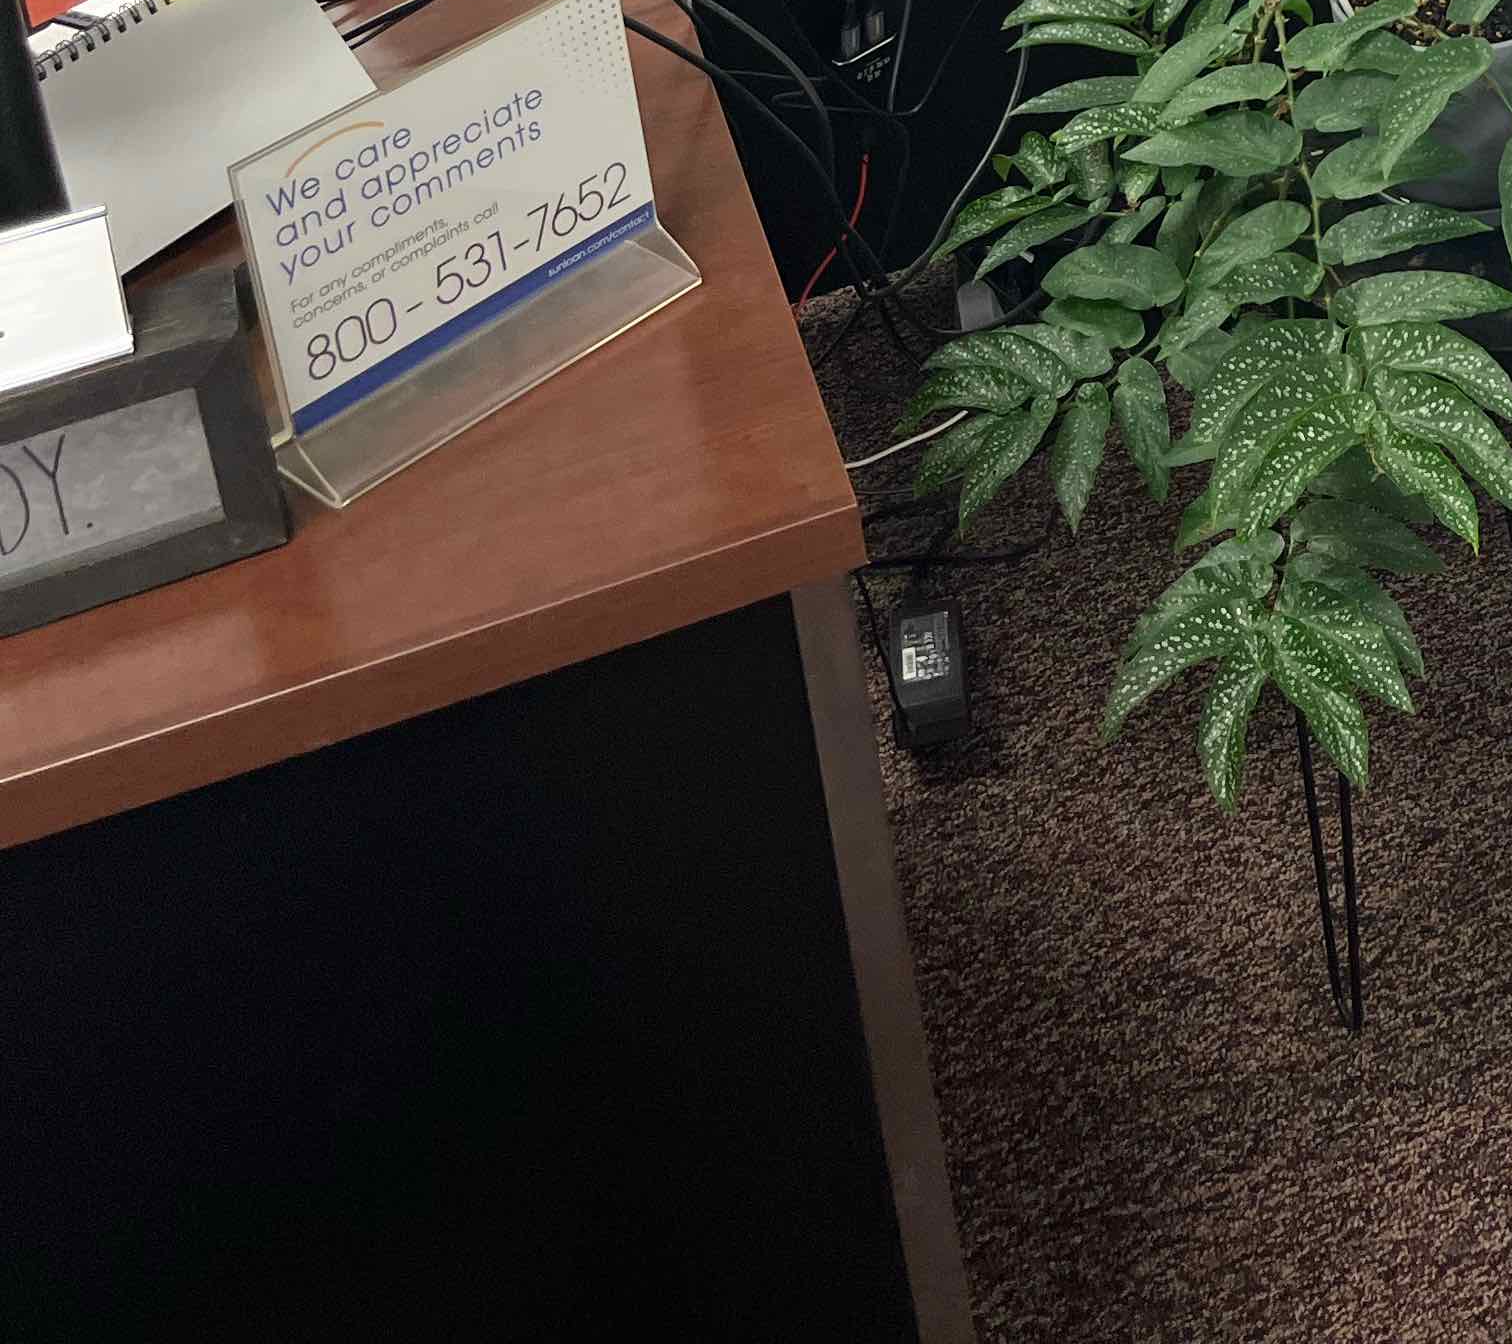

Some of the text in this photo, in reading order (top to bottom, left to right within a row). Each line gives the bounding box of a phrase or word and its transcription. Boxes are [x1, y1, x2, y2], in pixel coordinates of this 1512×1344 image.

[265, 128, 411, 216] We care
[276, 89, 542, 247] and appreciate
[280, 121, 541, 287] your comments
[371, 267, 387, 284] or
[390, 220, 470, 273] complaints
[473, 200, 500, 225] call
[290, 292, 315, 313] For
[319, 273, 348, 298] any
